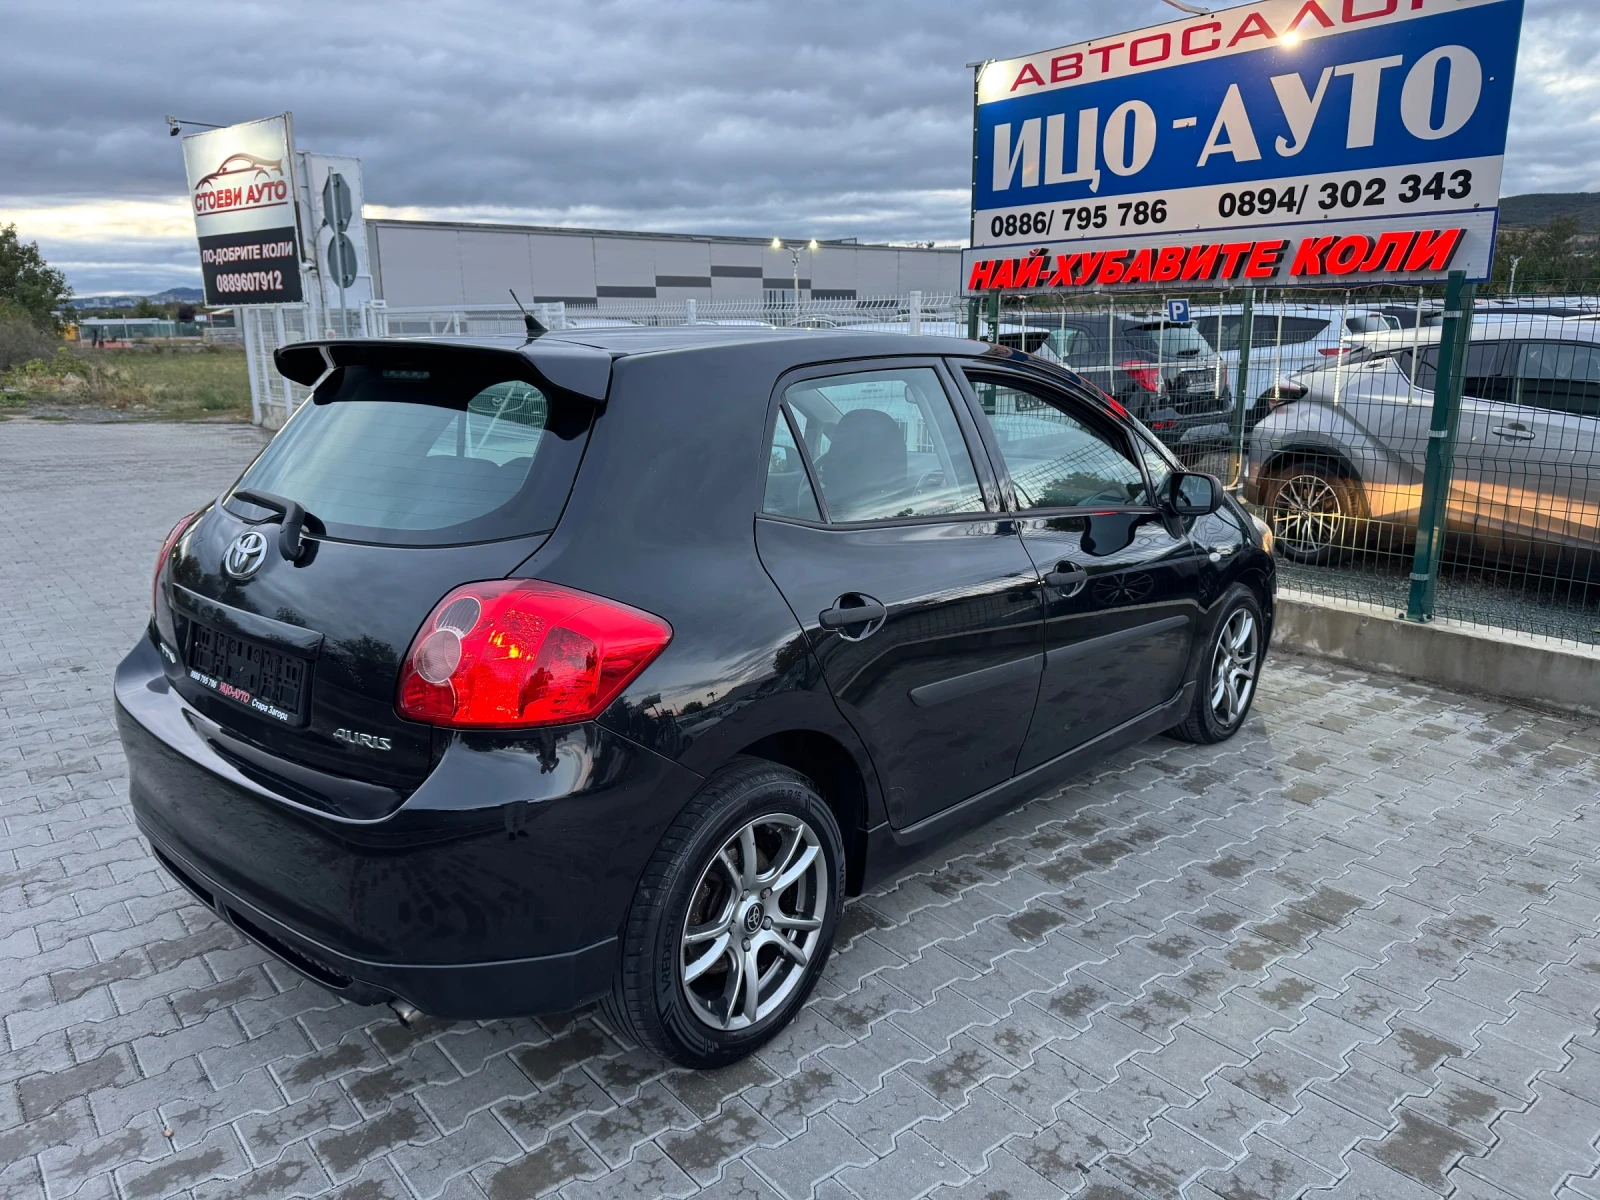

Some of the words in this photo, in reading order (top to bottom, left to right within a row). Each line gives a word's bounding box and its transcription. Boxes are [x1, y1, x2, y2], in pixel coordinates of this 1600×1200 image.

[1009, 0, 1423, 92] АВТОСАЛО
[195, 187, 242, 211] СТОЕВИ
[246, 180, 286, 204] АУТО
[1218, 185, 1309, 219] 0894/
[1319, 178, 1386, 208] 302
[1398, 169, 1473, 204] 343
[990, 207, 1053, 238] 0886/
[1062, 206, 1108, 232] 795
[1118, 200, 1167, 228] 786
[203, 245, 261, 265] ПО-ДОБРИТЕ
[262, 241, 293, 258] КОЛИ
[967, 239, 1291, 290] НАЙ-ХУБАВИТЕ
[1290, 228, 1467, 276] КОЛИ
[217, 271, 282, 292] 0889607912
[1171, 302, 1185, 320] P
[333, 728, 391, 750] AURIS
